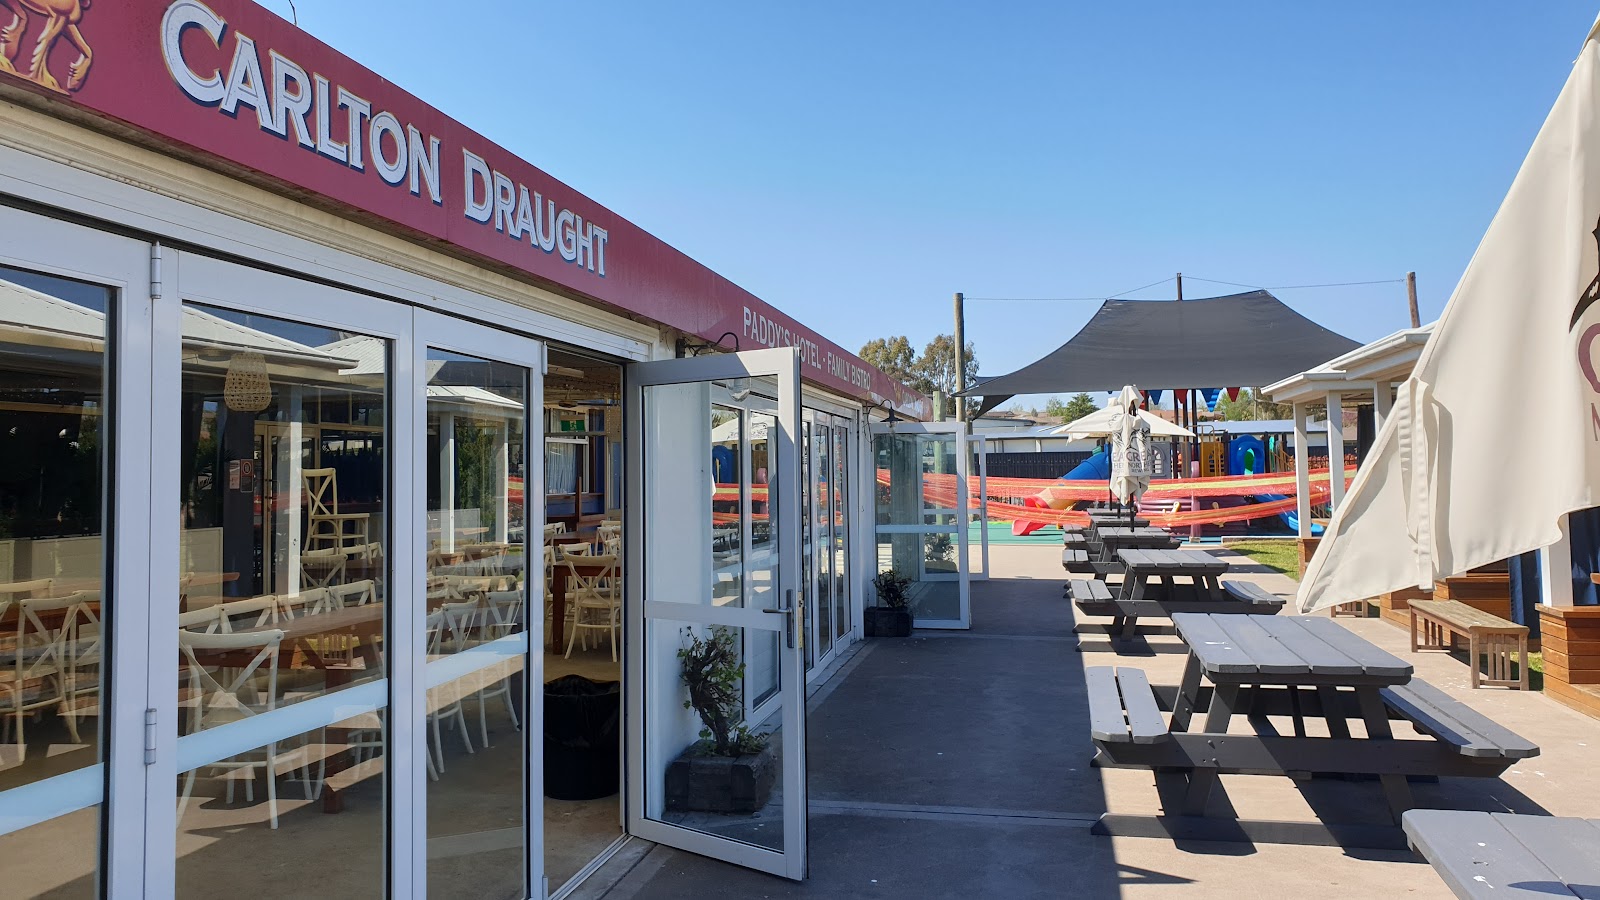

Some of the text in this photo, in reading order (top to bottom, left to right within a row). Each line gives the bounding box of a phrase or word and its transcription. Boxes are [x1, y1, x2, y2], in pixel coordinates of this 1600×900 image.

[160, 0, 608, 277] CARLTON DRAUGHT
[743, 306, 790, 348] PADDY'S
[793, 333, 822, 369] HOTEL
[827, 351, 850, 382] FAMILY
[851, 364, 871, 391] BISTRO
